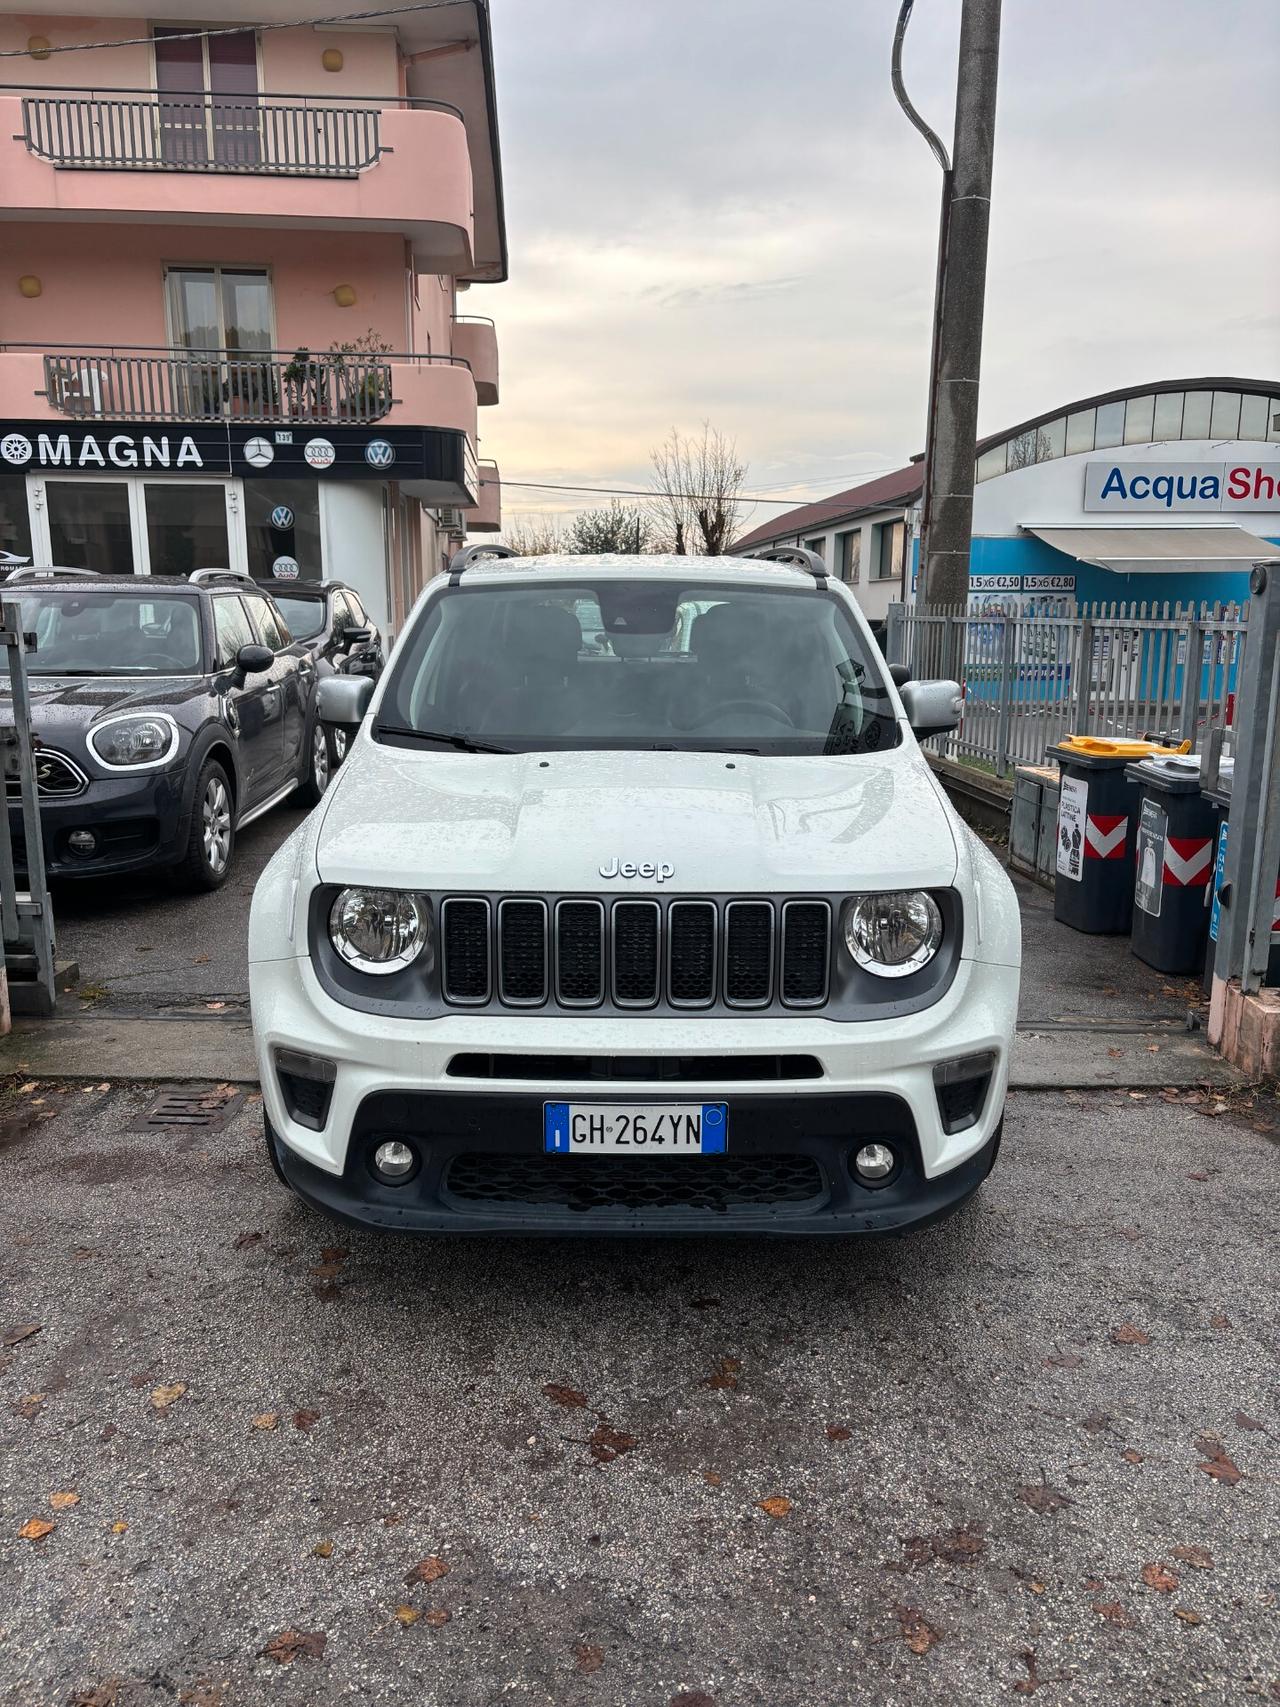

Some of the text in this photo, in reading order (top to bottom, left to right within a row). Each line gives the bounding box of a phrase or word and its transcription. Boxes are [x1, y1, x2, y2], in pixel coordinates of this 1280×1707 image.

[1101, 467, 1280, 507] Acqua Sh
[599, 857, 675, 883] Jeep
